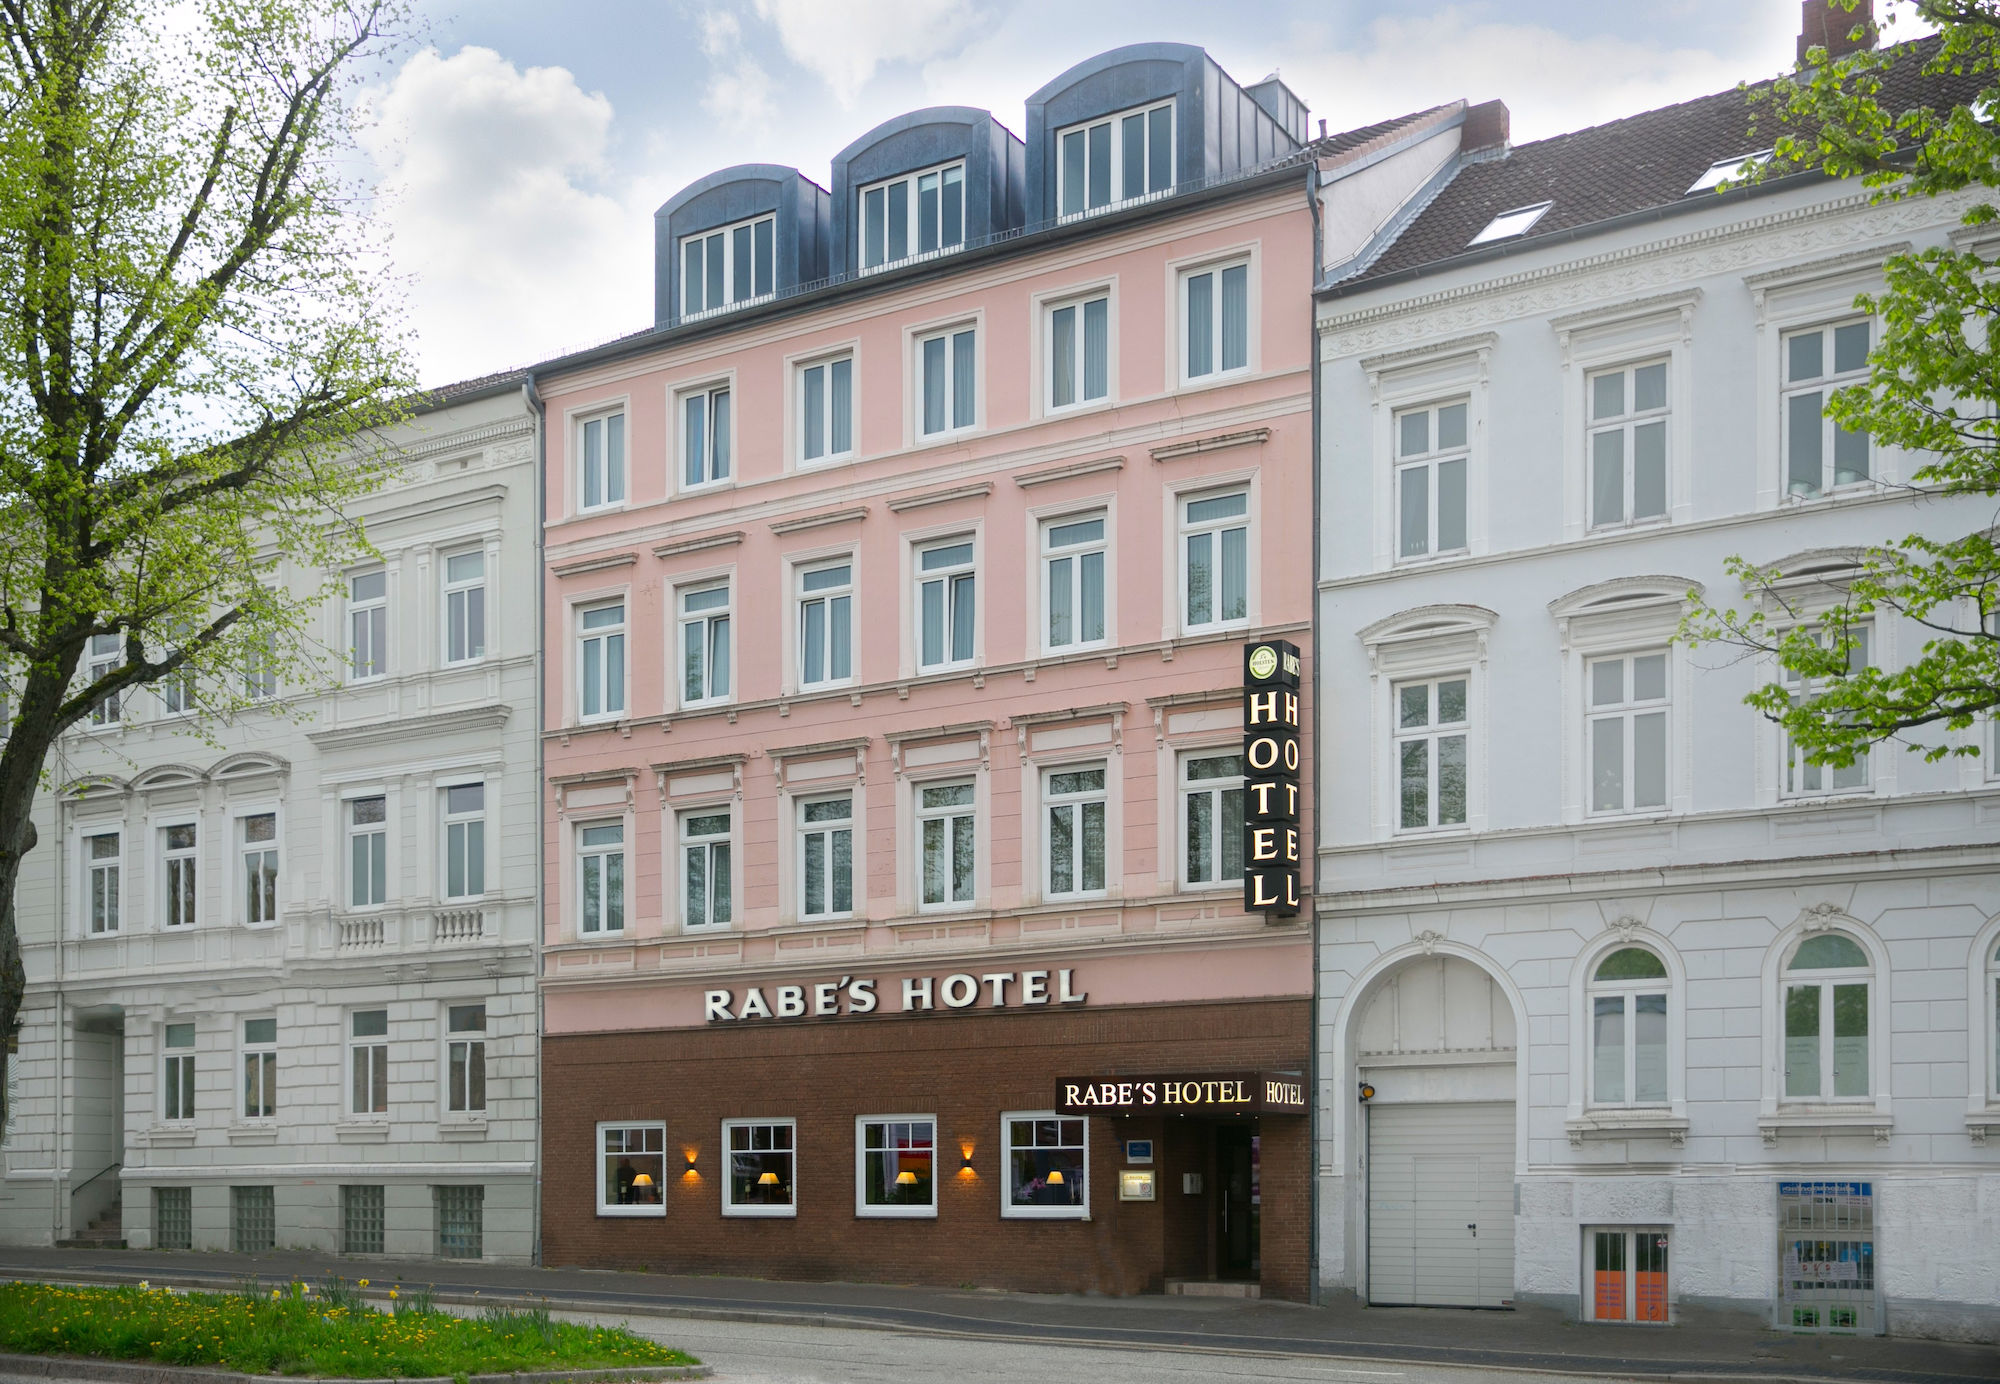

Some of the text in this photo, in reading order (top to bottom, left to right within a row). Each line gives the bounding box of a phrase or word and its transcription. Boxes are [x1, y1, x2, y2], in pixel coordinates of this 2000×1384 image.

[1248, 690, 1280, 907] HOTEL
[1284, 691, 1299, 907] HOTEL
[704, 968, 1089, 1022] RABE'S HOTEL
[1064, 1080, 1252, 1106] RABE'S HOTEL
[1265, 1081, 1305, 1105] HOTEL
